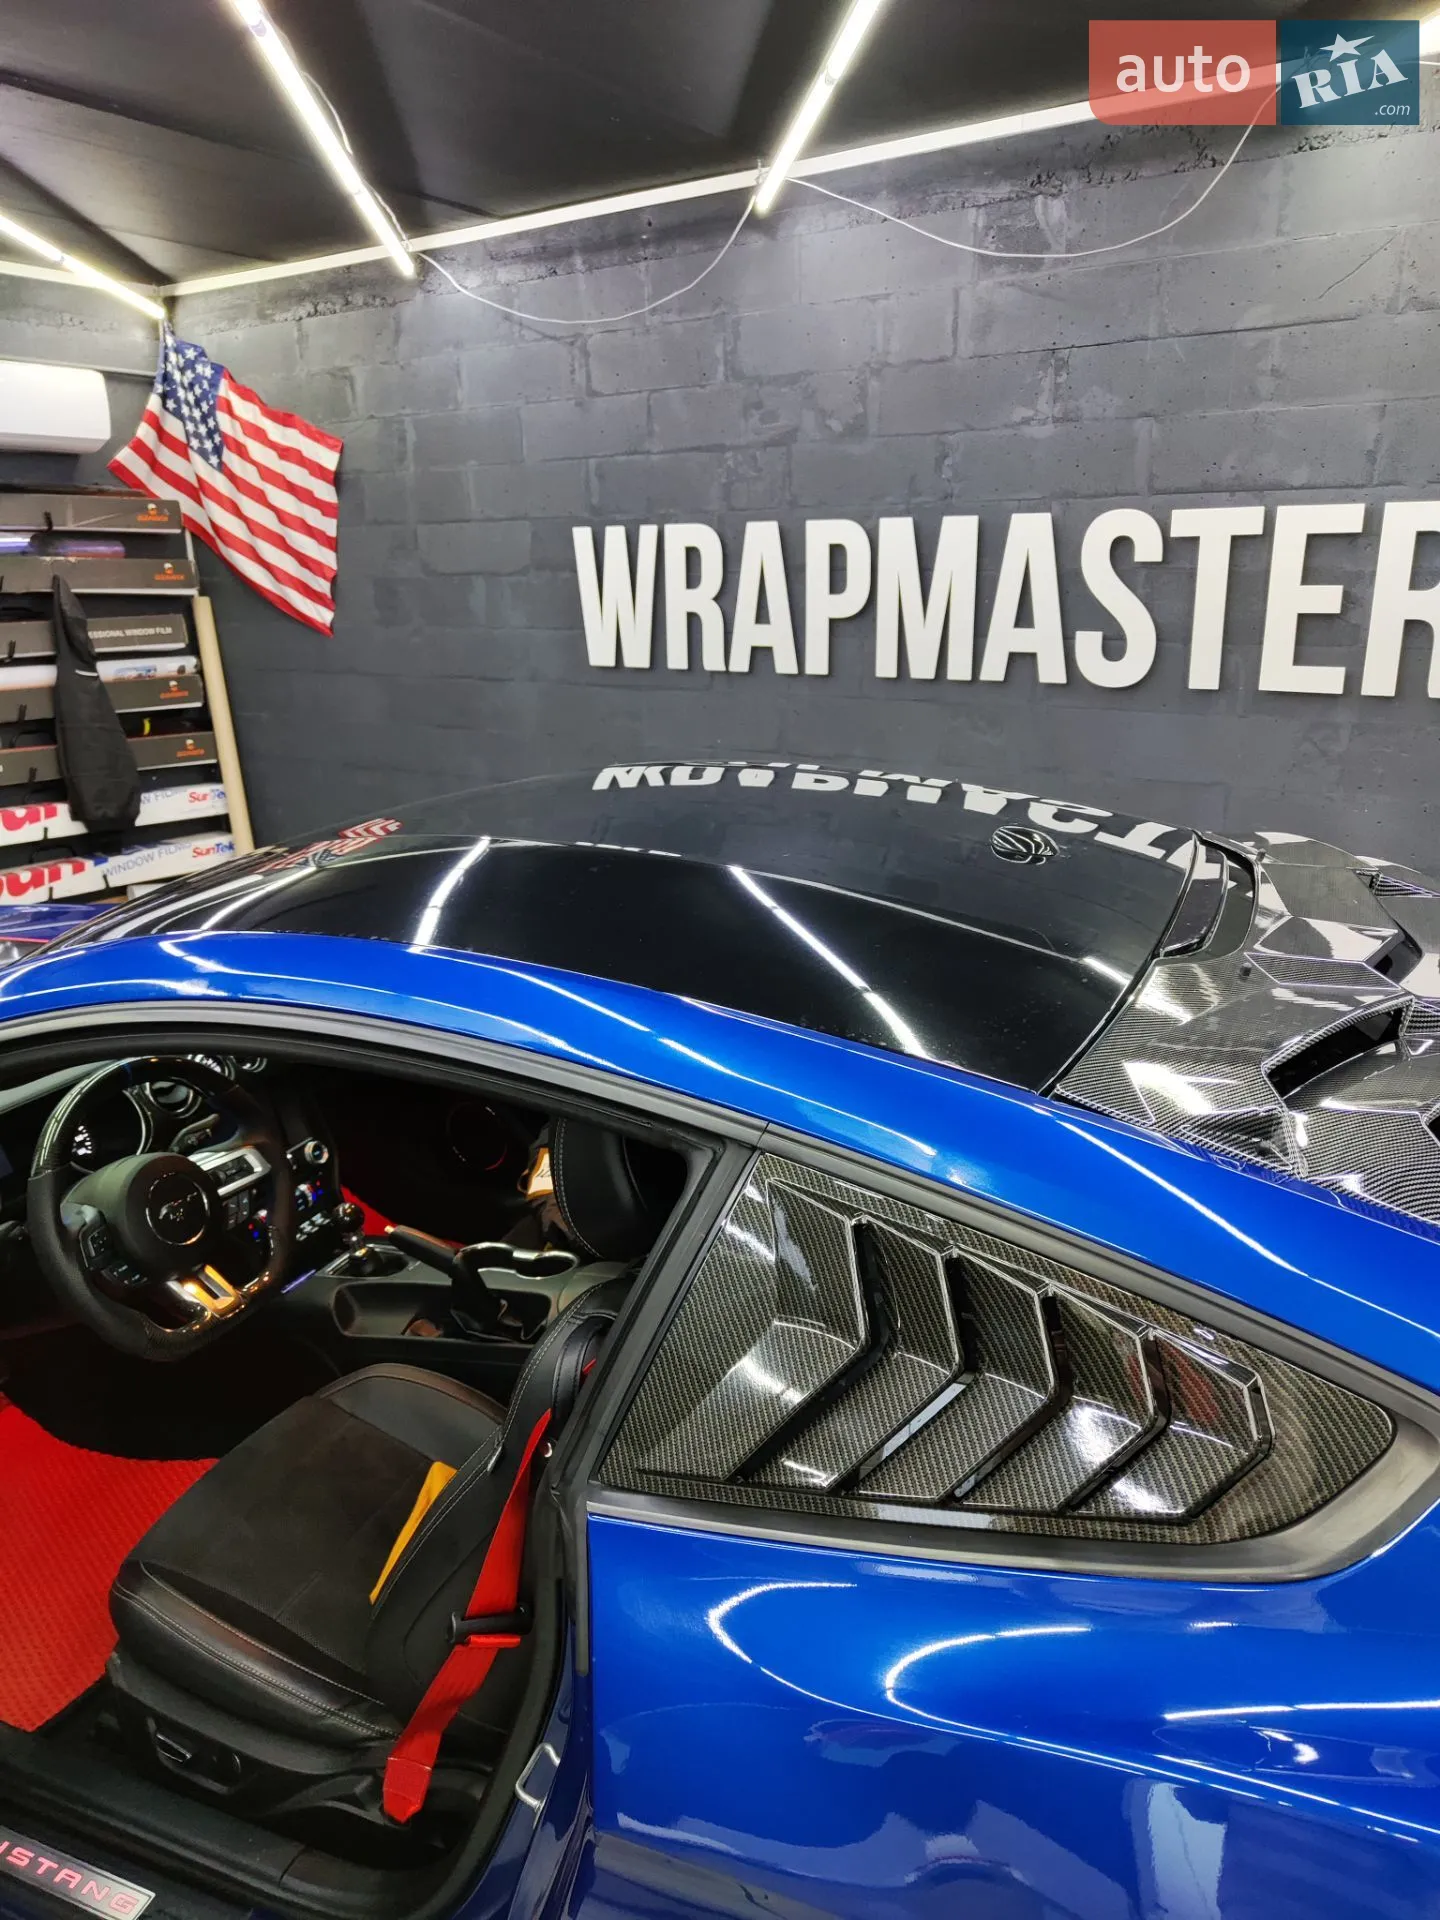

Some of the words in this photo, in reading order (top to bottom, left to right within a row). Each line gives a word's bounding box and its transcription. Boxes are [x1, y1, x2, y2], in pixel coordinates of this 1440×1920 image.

[572, 500, 1440, 699] WRAPMASTER
[192, 840, 235, 859] SunTek
[101, 853, 155, 877] WINDOW
